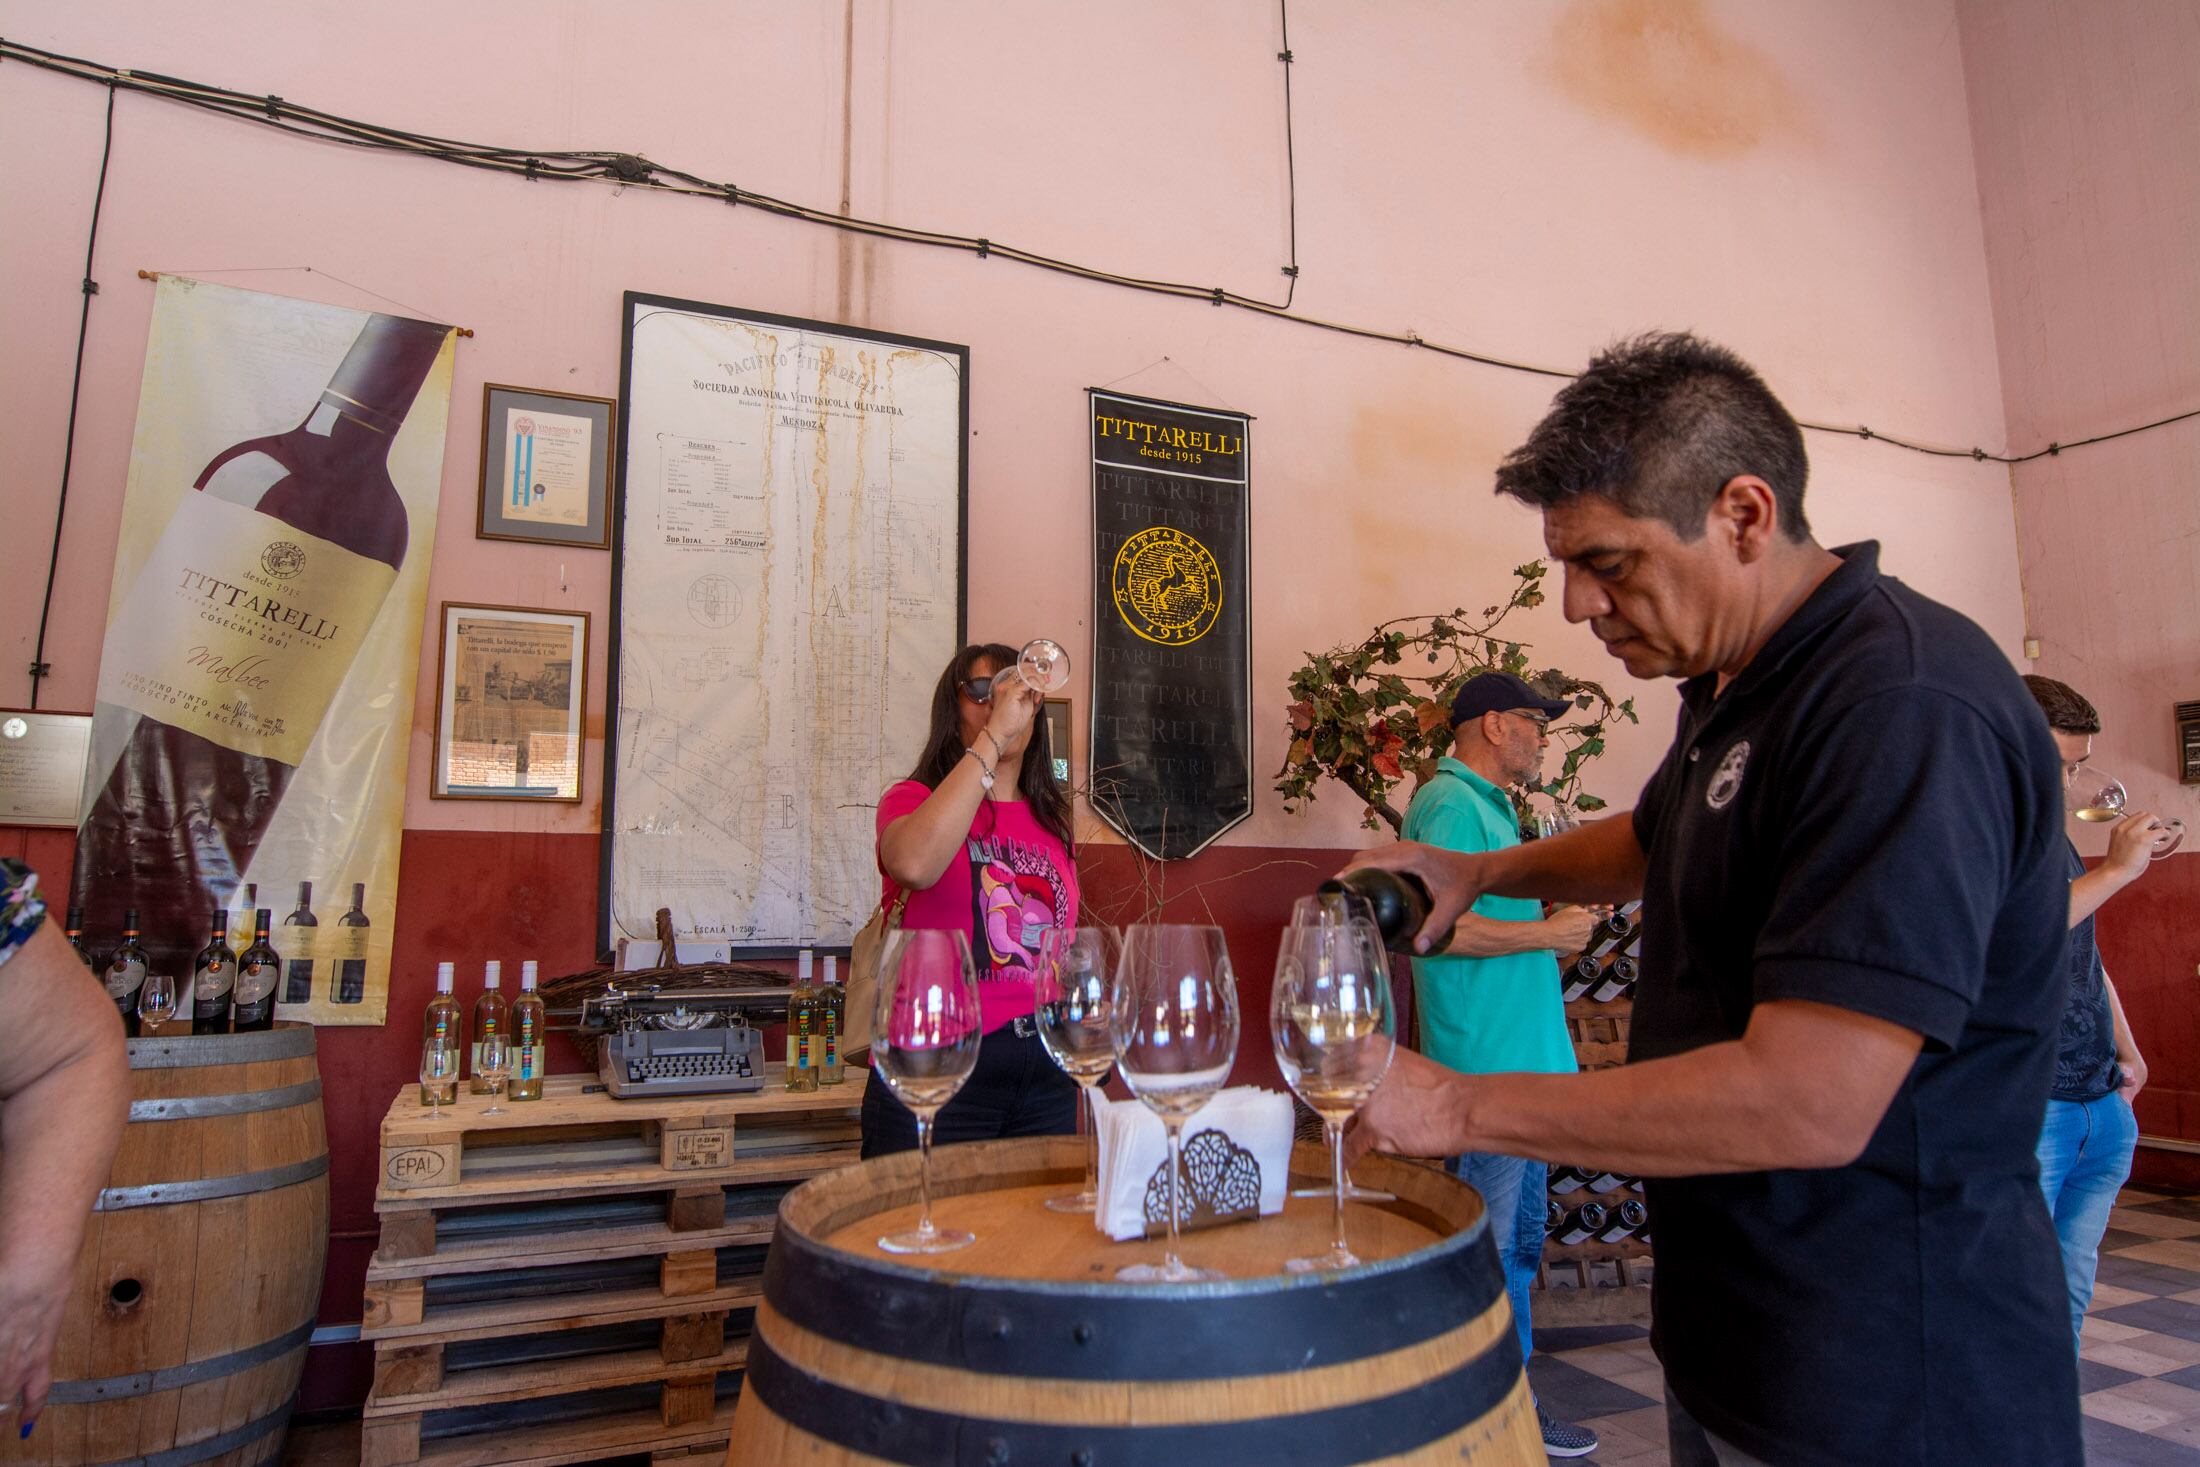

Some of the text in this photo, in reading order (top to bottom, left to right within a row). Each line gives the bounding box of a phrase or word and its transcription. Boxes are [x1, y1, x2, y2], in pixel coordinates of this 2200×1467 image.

[692, 379, 740, 395] SOCIEDAD
[780, 415, 825, 429] MENDOZA
[1096, 415, 1242, 455] TITTARELLI
[1139, 445, 1202, 465] desde 1915
[243, 570, 273, 588] desde
[178, 567, 339, 641] TITTARELLI
[200, 611, 288, 649] COSECHA 2001
[1145, 624, 1197, 639] 1915
[187, 646, 271, 690] Malbec
[177, 690, 208, 706] TINTO
[183, 702, 199, 713] DE
[715, 948, 722, 958] 6
[396, 1156, 436, 1176] EPAL
